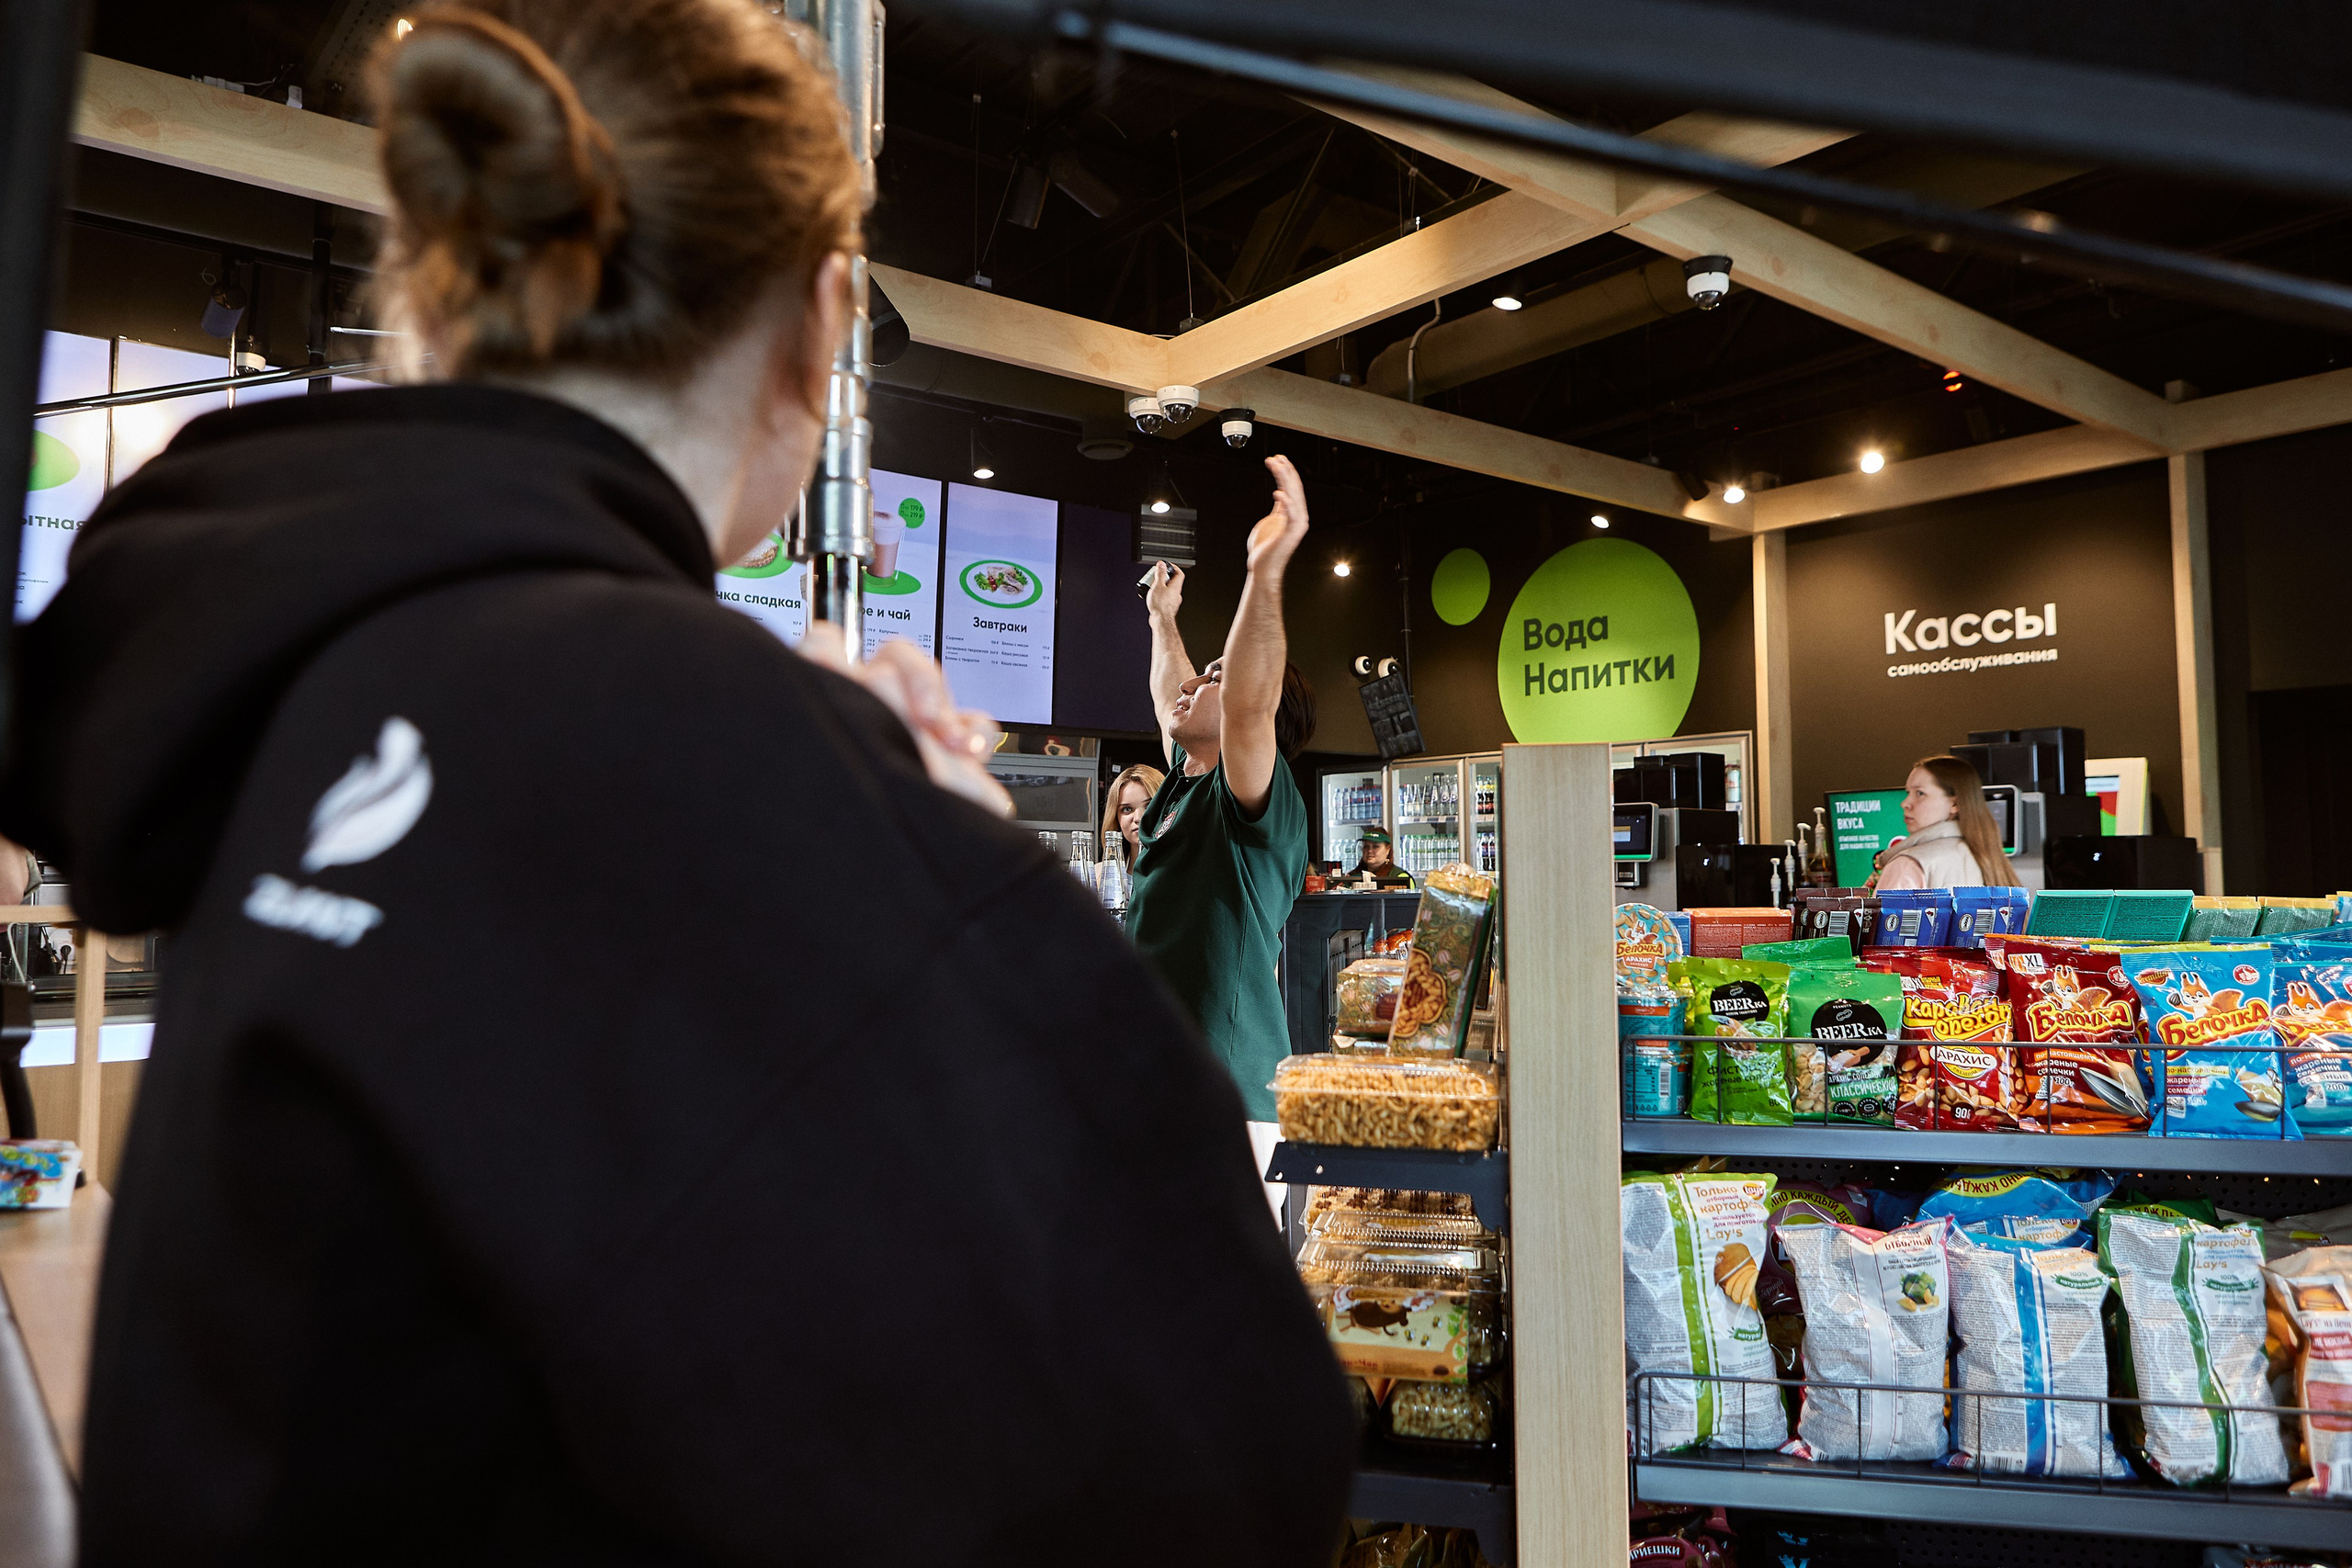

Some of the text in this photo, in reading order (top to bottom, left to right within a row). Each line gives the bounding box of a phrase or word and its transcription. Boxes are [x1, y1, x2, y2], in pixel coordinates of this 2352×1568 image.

[744, 593, 801, 609] сладкая
[876, 608, 885, 617] и
[888, 609, 911, 621] чай
[973, 616, 1027, 633] Завтраки
[1884, 603, 2057, 654] Кассы
[1523, 615, 1608, 651] Вода
[1887, 648, 2058, 677] самообслуживания
[1524, 654, 1674, 696] Напитки
[1835, 799, 1881, 814] ТРАДИЦИИ
[1837, 817, 1864, 829] ВКУСА
[2024, 954, 2043, 967] XL
[1937, 1049, 1992, 1067] АРАХИС
[2295, 1057, 2342, 1073] жареные
[2297, 1065, 2341, 1077] семечки
[1830, 1077, 1896, 1099] КЛАССИЧЕСКИЙ
[1693, 1186, 1738, 1197] Только
[1790, 1190, 1839, 1212] КАЖДЫЙ
[1836, 1210, 1853, 1224] ДЕ
[1706, 1228, 1744, 1241] Lay's
[2018, 1229, 2069, 1242] картофе
[2196, 1260, 2228, 1270] Lay's
